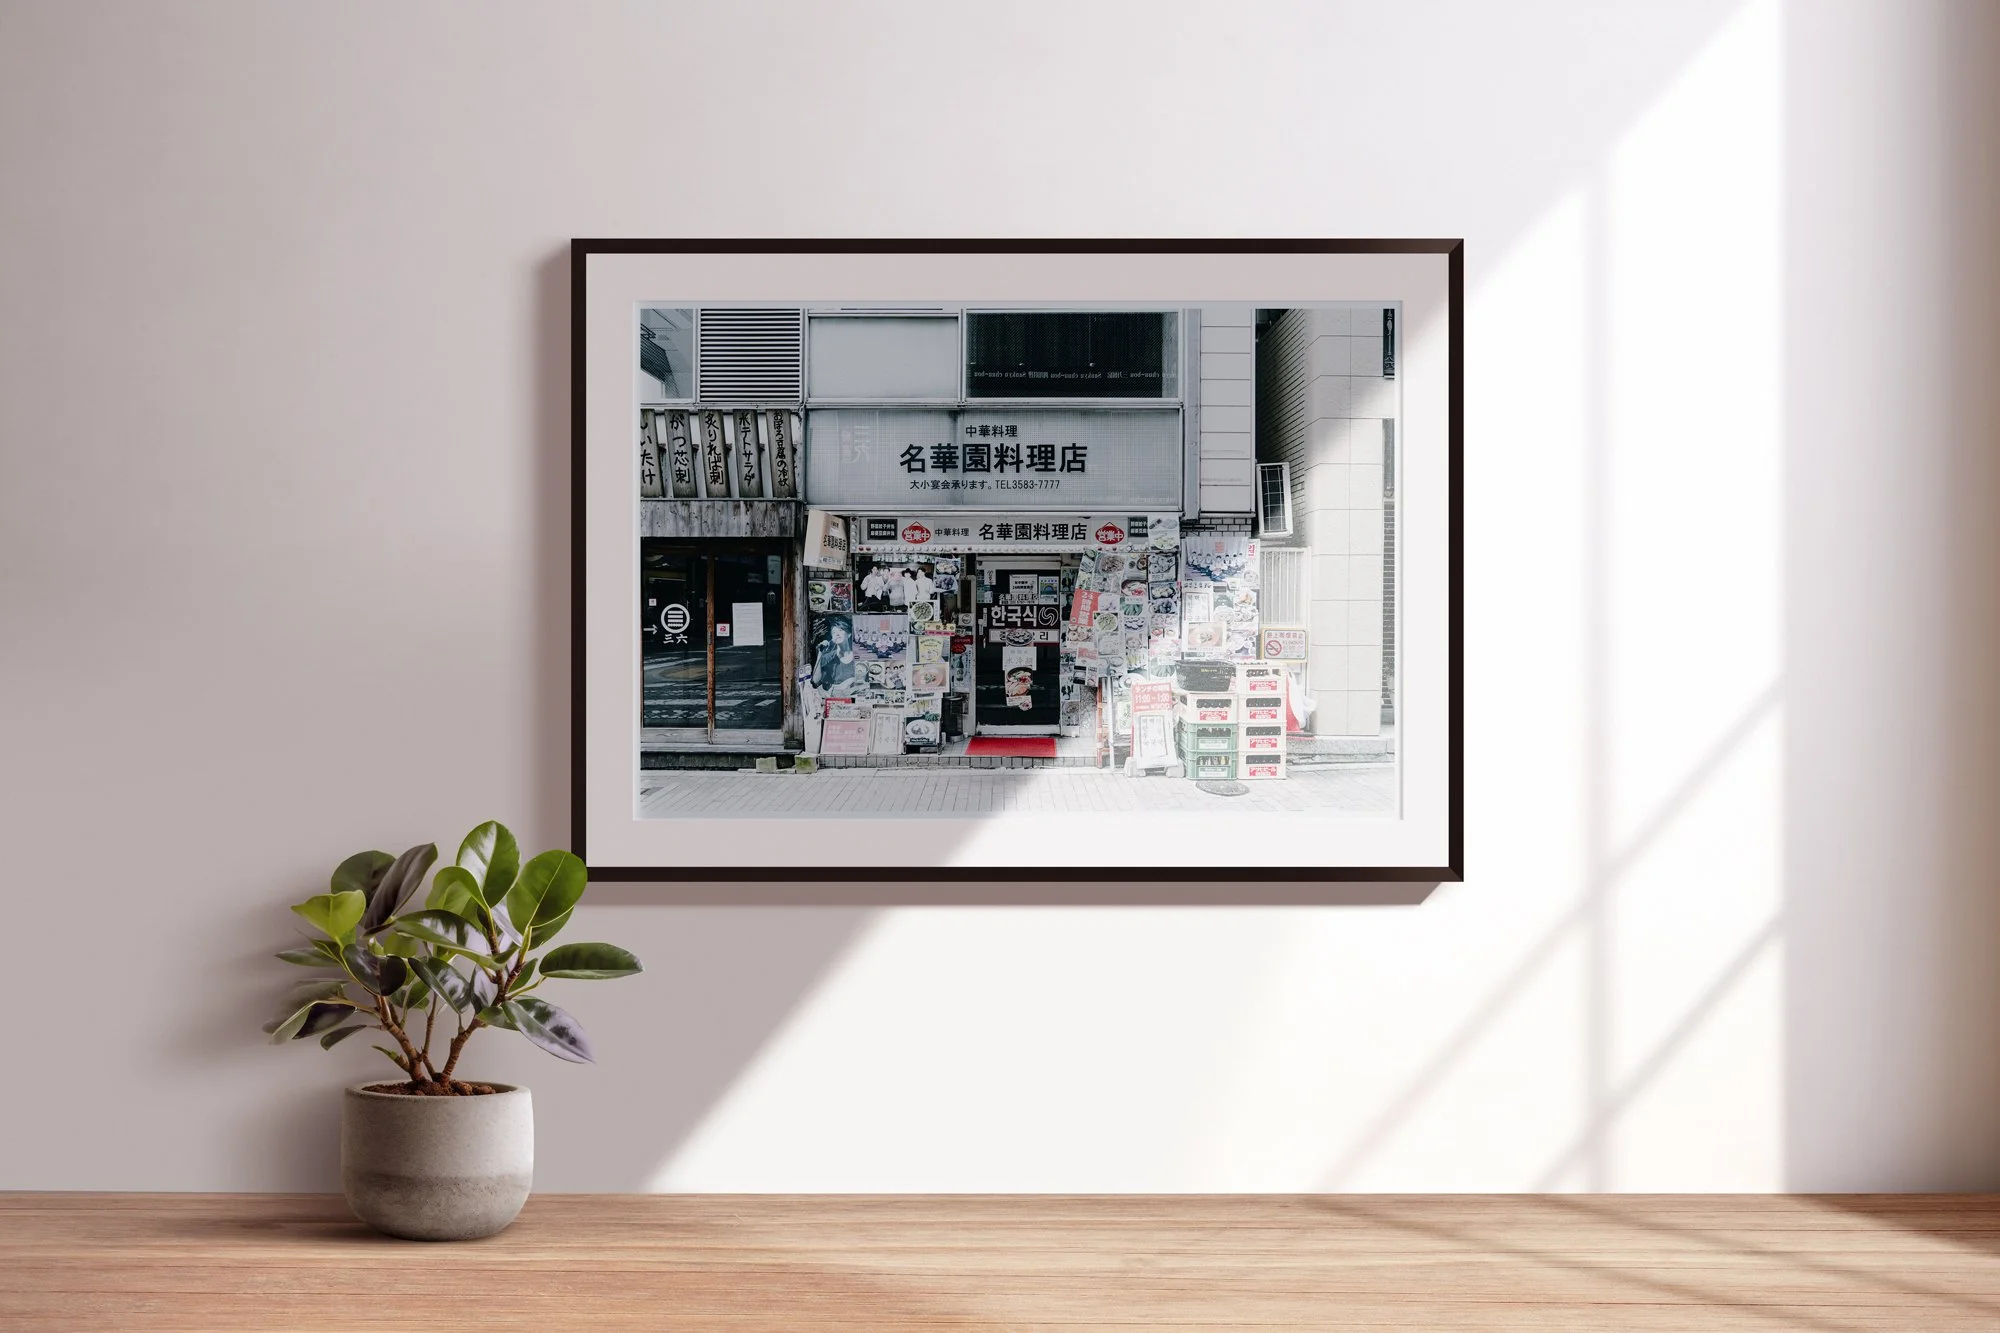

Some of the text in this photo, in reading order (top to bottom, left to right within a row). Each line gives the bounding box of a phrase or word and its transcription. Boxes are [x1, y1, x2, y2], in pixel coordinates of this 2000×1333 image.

[965, 424, 1018, 438] 中華料理
[899, 442, 1088, 474] 名華園料理店
[903, 529, 931, 541] 営業中
[934, 527, 970, 537] 中華料理
[978, 523, 1088, 541] 名華園料理店
[1097, 530, 1125, 541] 営業中
[990, 605, 1038, 627] 한국식
[663, 633, 688, 645] 三六
